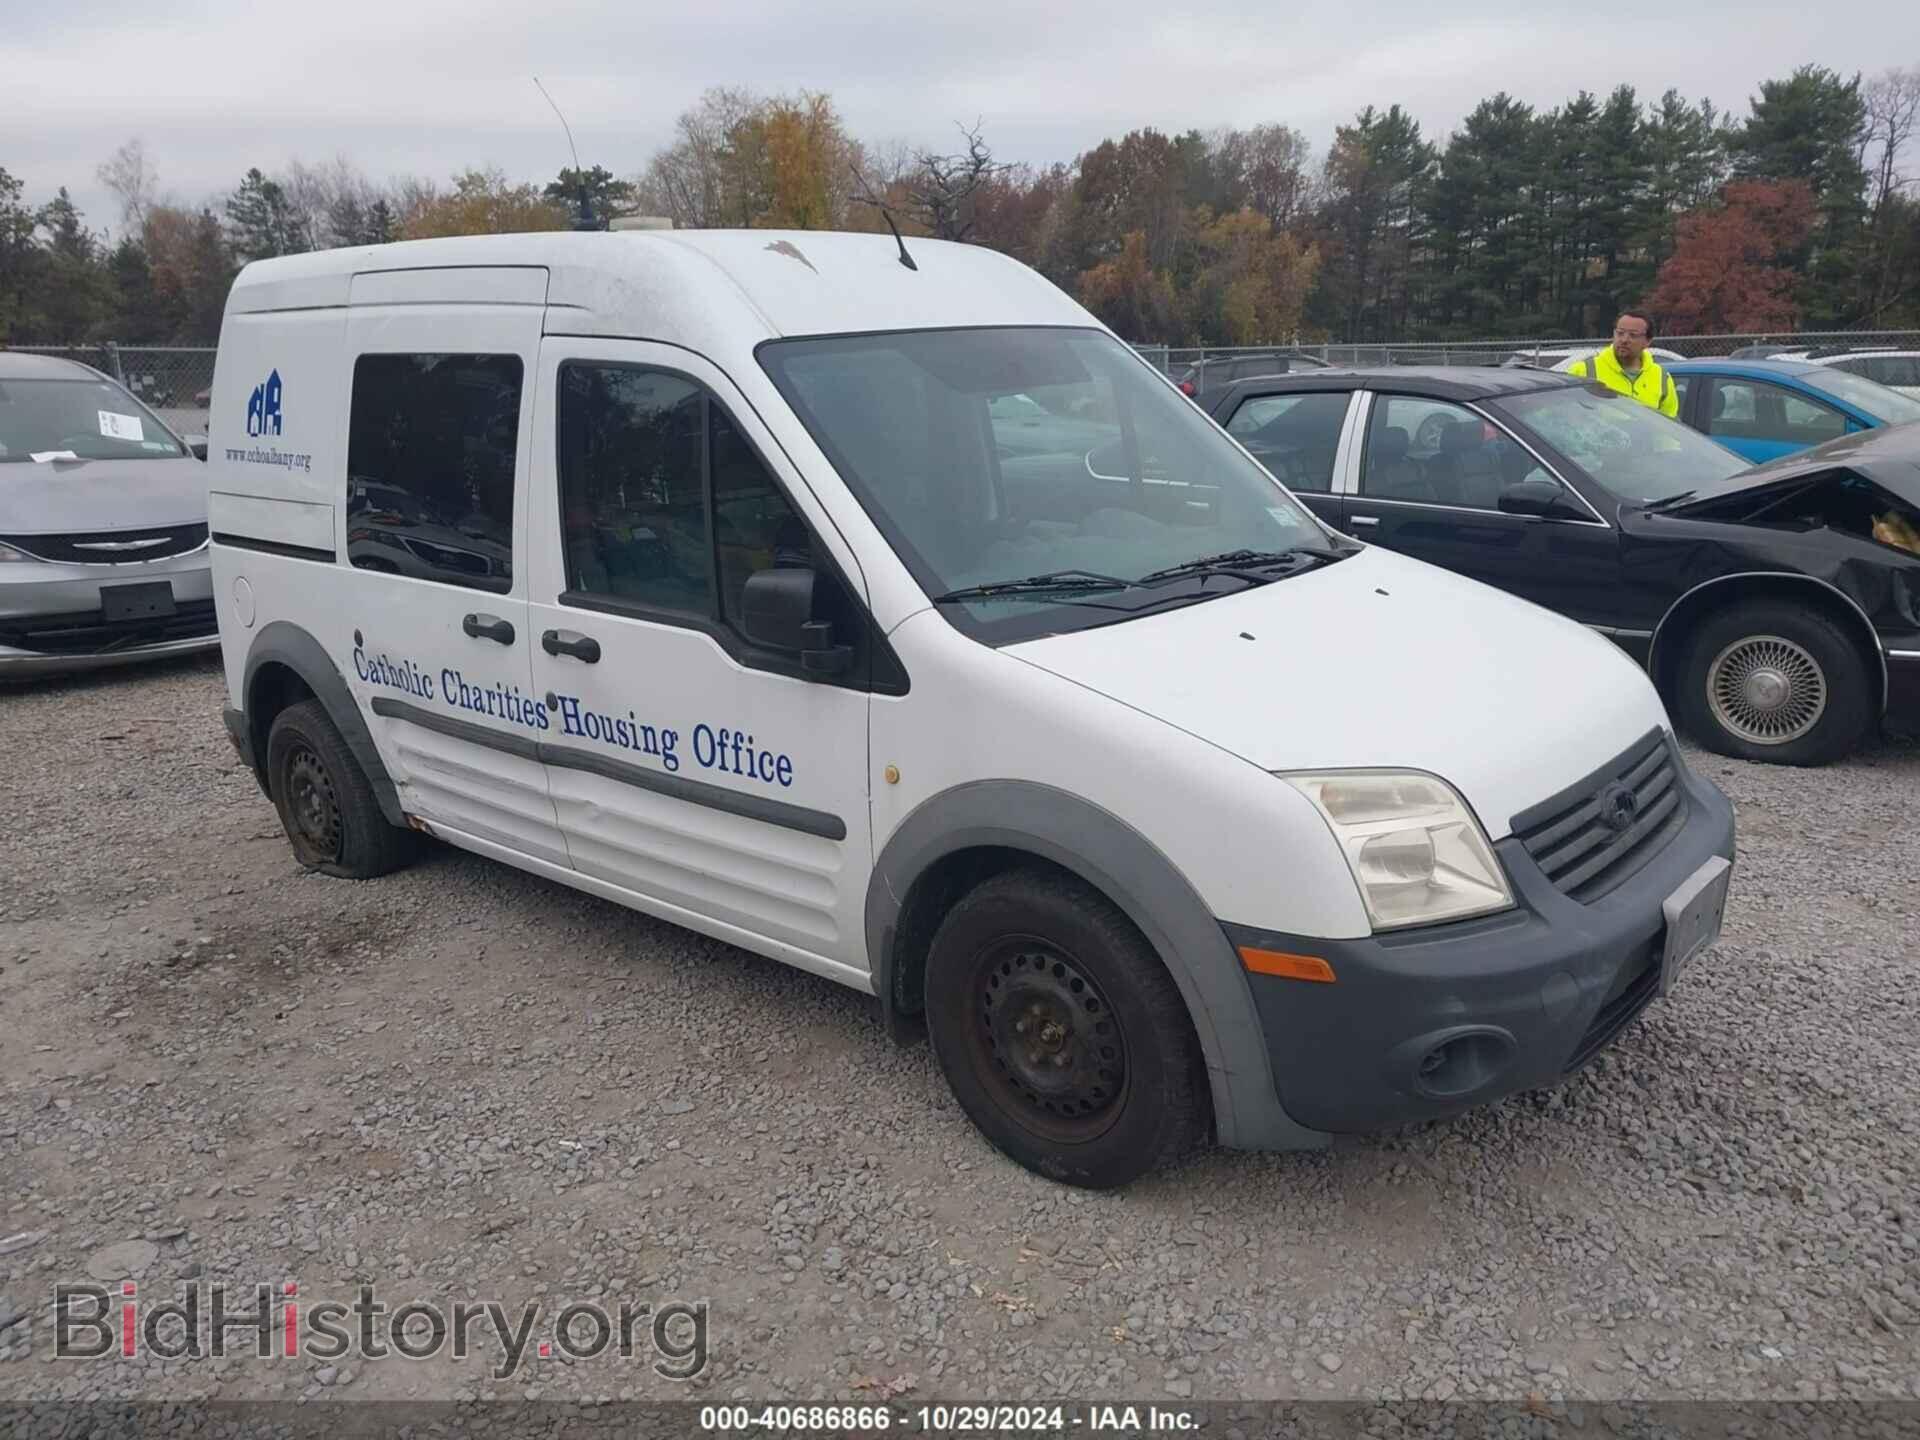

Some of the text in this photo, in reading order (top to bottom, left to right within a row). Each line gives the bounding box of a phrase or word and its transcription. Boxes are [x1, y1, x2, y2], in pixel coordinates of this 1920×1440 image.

[353, 648, 794, 787] Catholic Charities Housing Office
